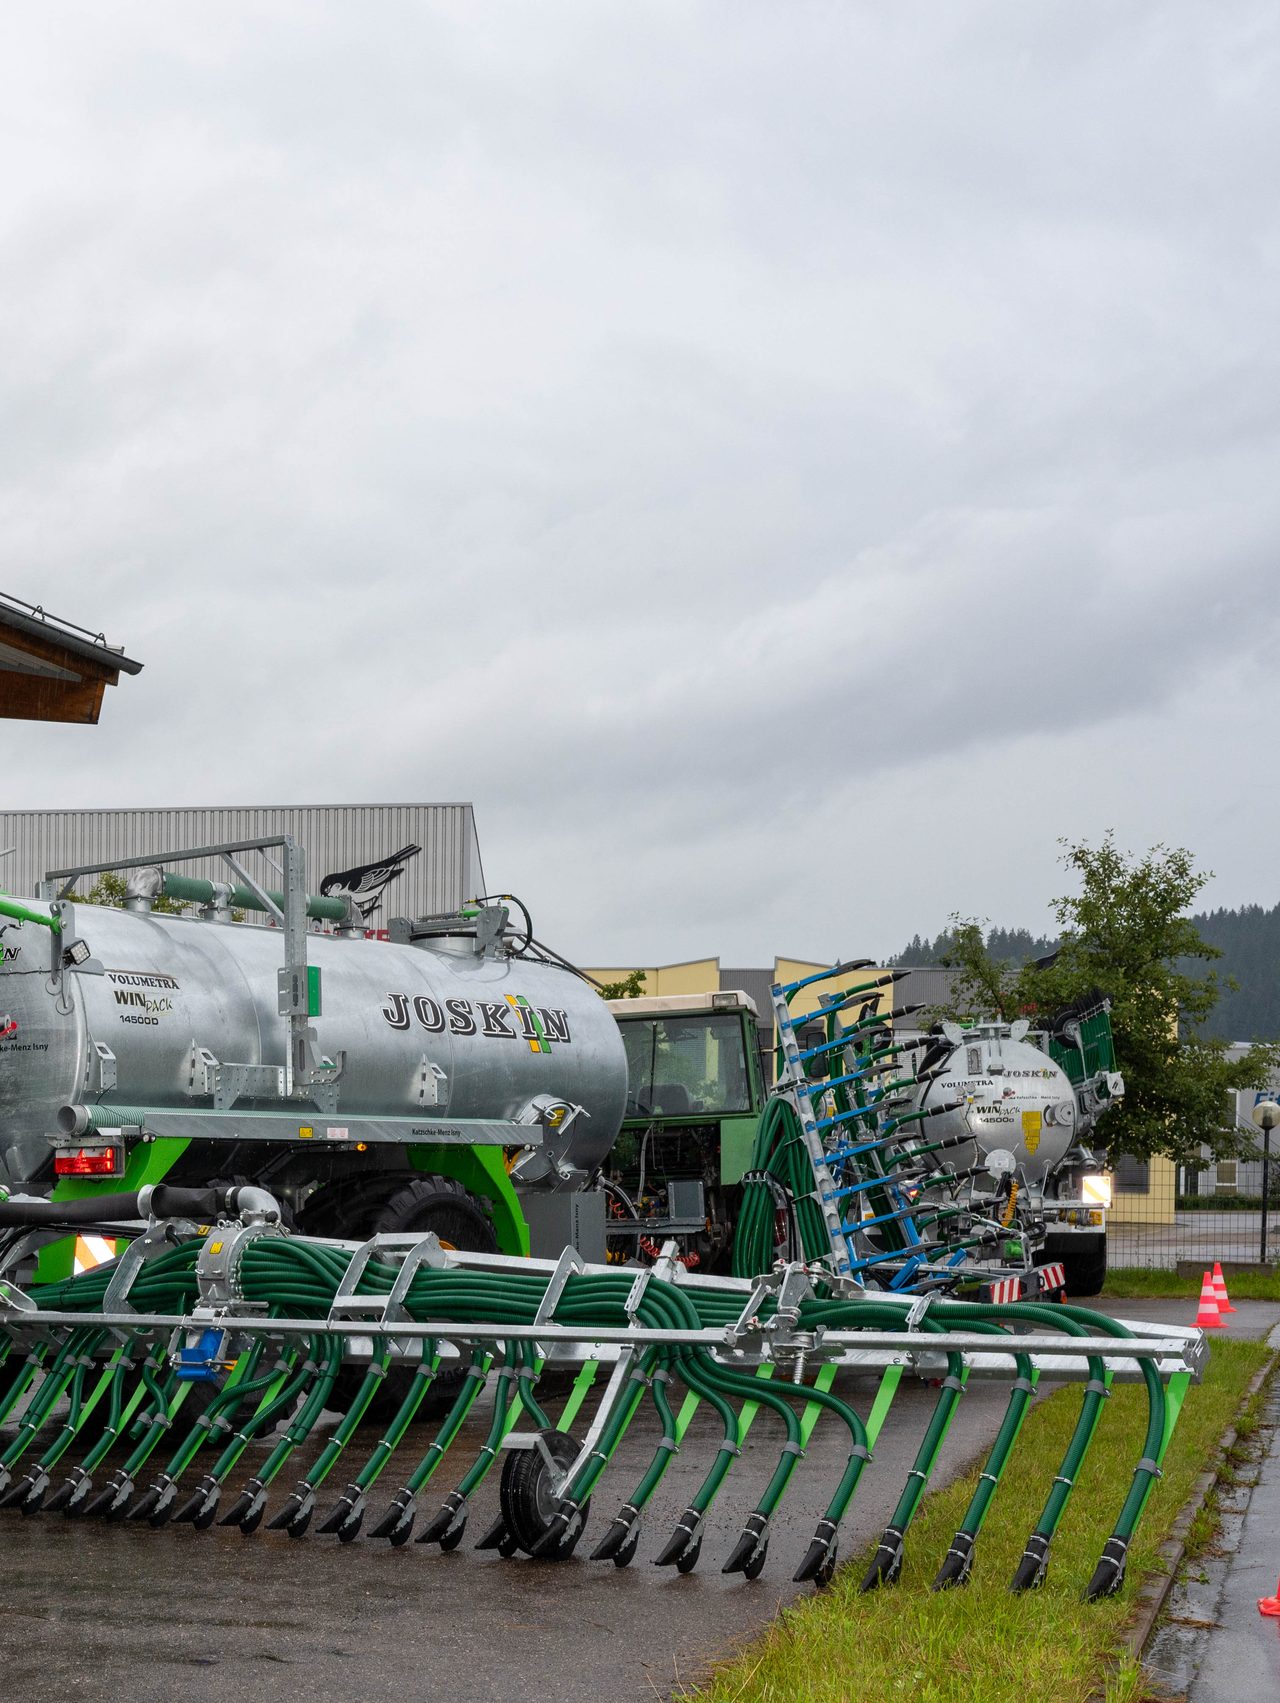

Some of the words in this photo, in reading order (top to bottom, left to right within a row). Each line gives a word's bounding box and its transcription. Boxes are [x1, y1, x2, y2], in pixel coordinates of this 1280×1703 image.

[108, 973, 180, 990] VOLUMETRA
[119, 1014, 159, 1026] 14500D
[381, 992, 571, 1043] JOSKIN
[33, 1042, 49, 1052] Isny
[1004, 1069, 1058, 1078] JOSKIN
